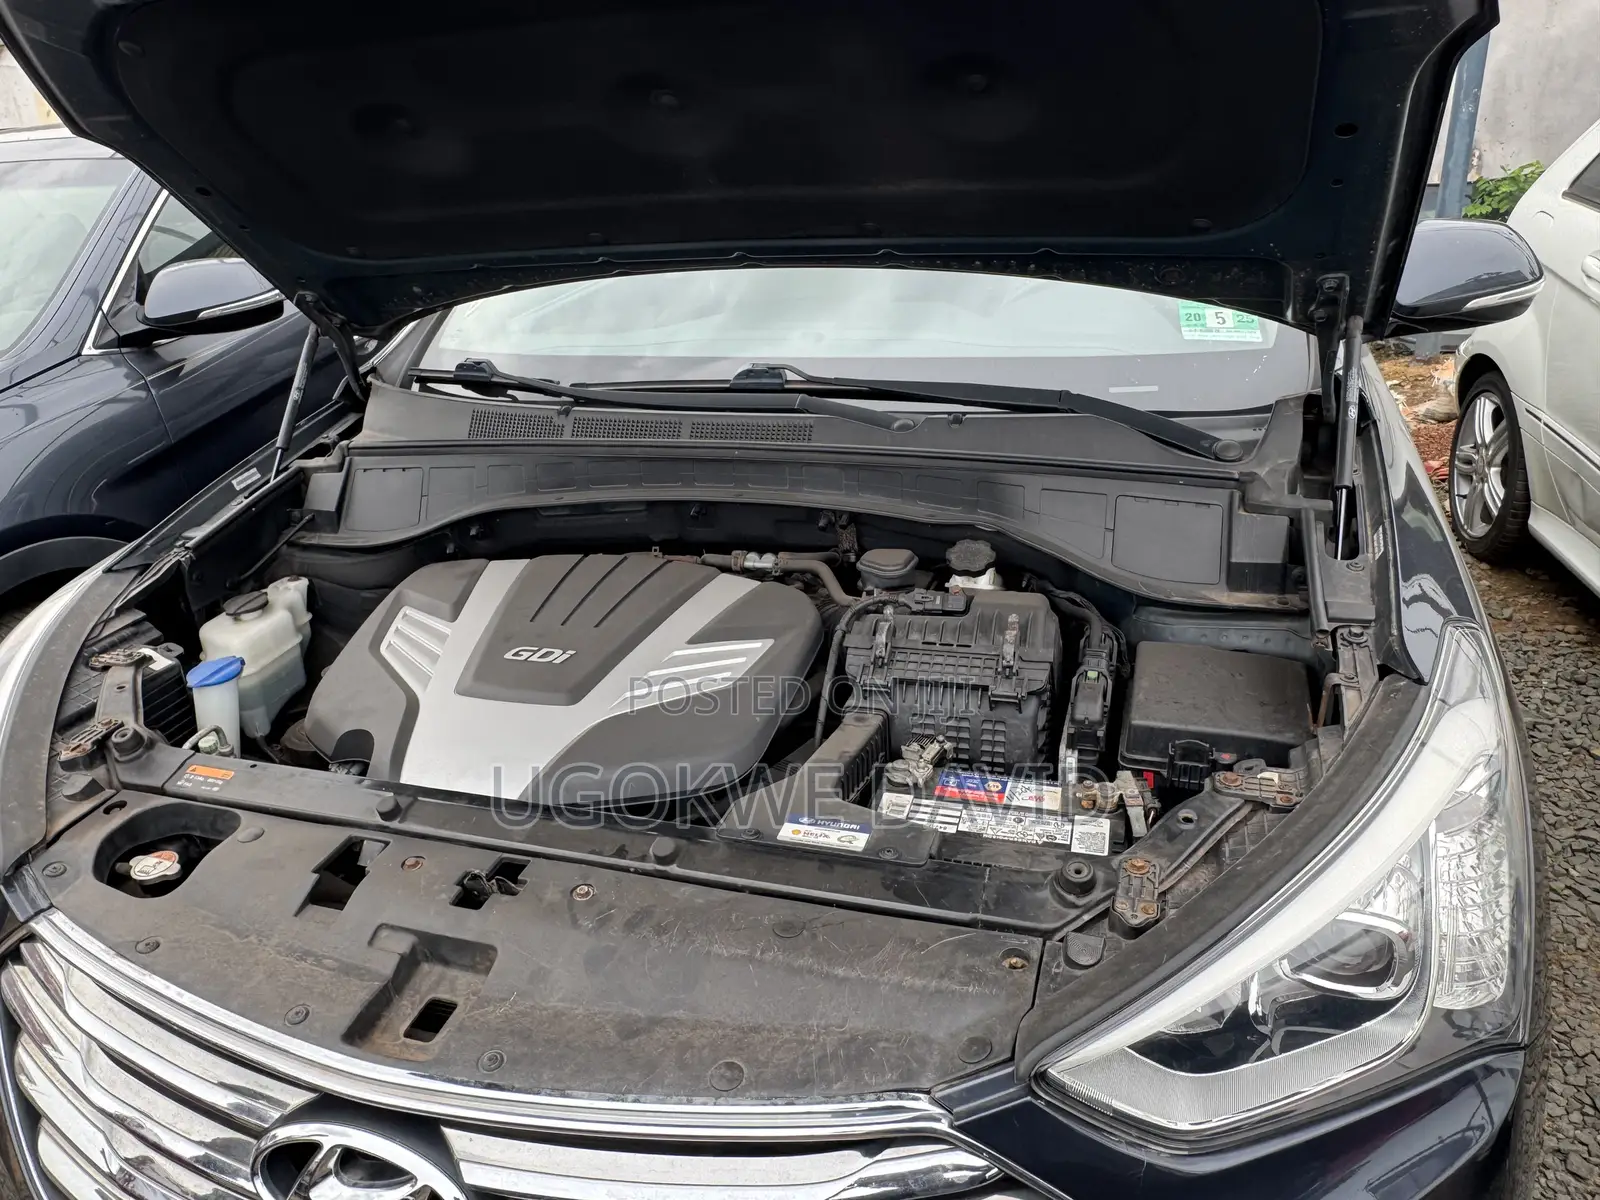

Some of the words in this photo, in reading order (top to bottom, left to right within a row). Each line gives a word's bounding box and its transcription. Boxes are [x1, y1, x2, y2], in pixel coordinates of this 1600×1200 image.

[1184, 312, 1202, 322] 20
[1214, 311, 1227, 326] 5
[1235, 314, 1255, 324] 25
[503, 646, 577, 664] GDi
[816, 820, 861, 831] HYUNDAI
